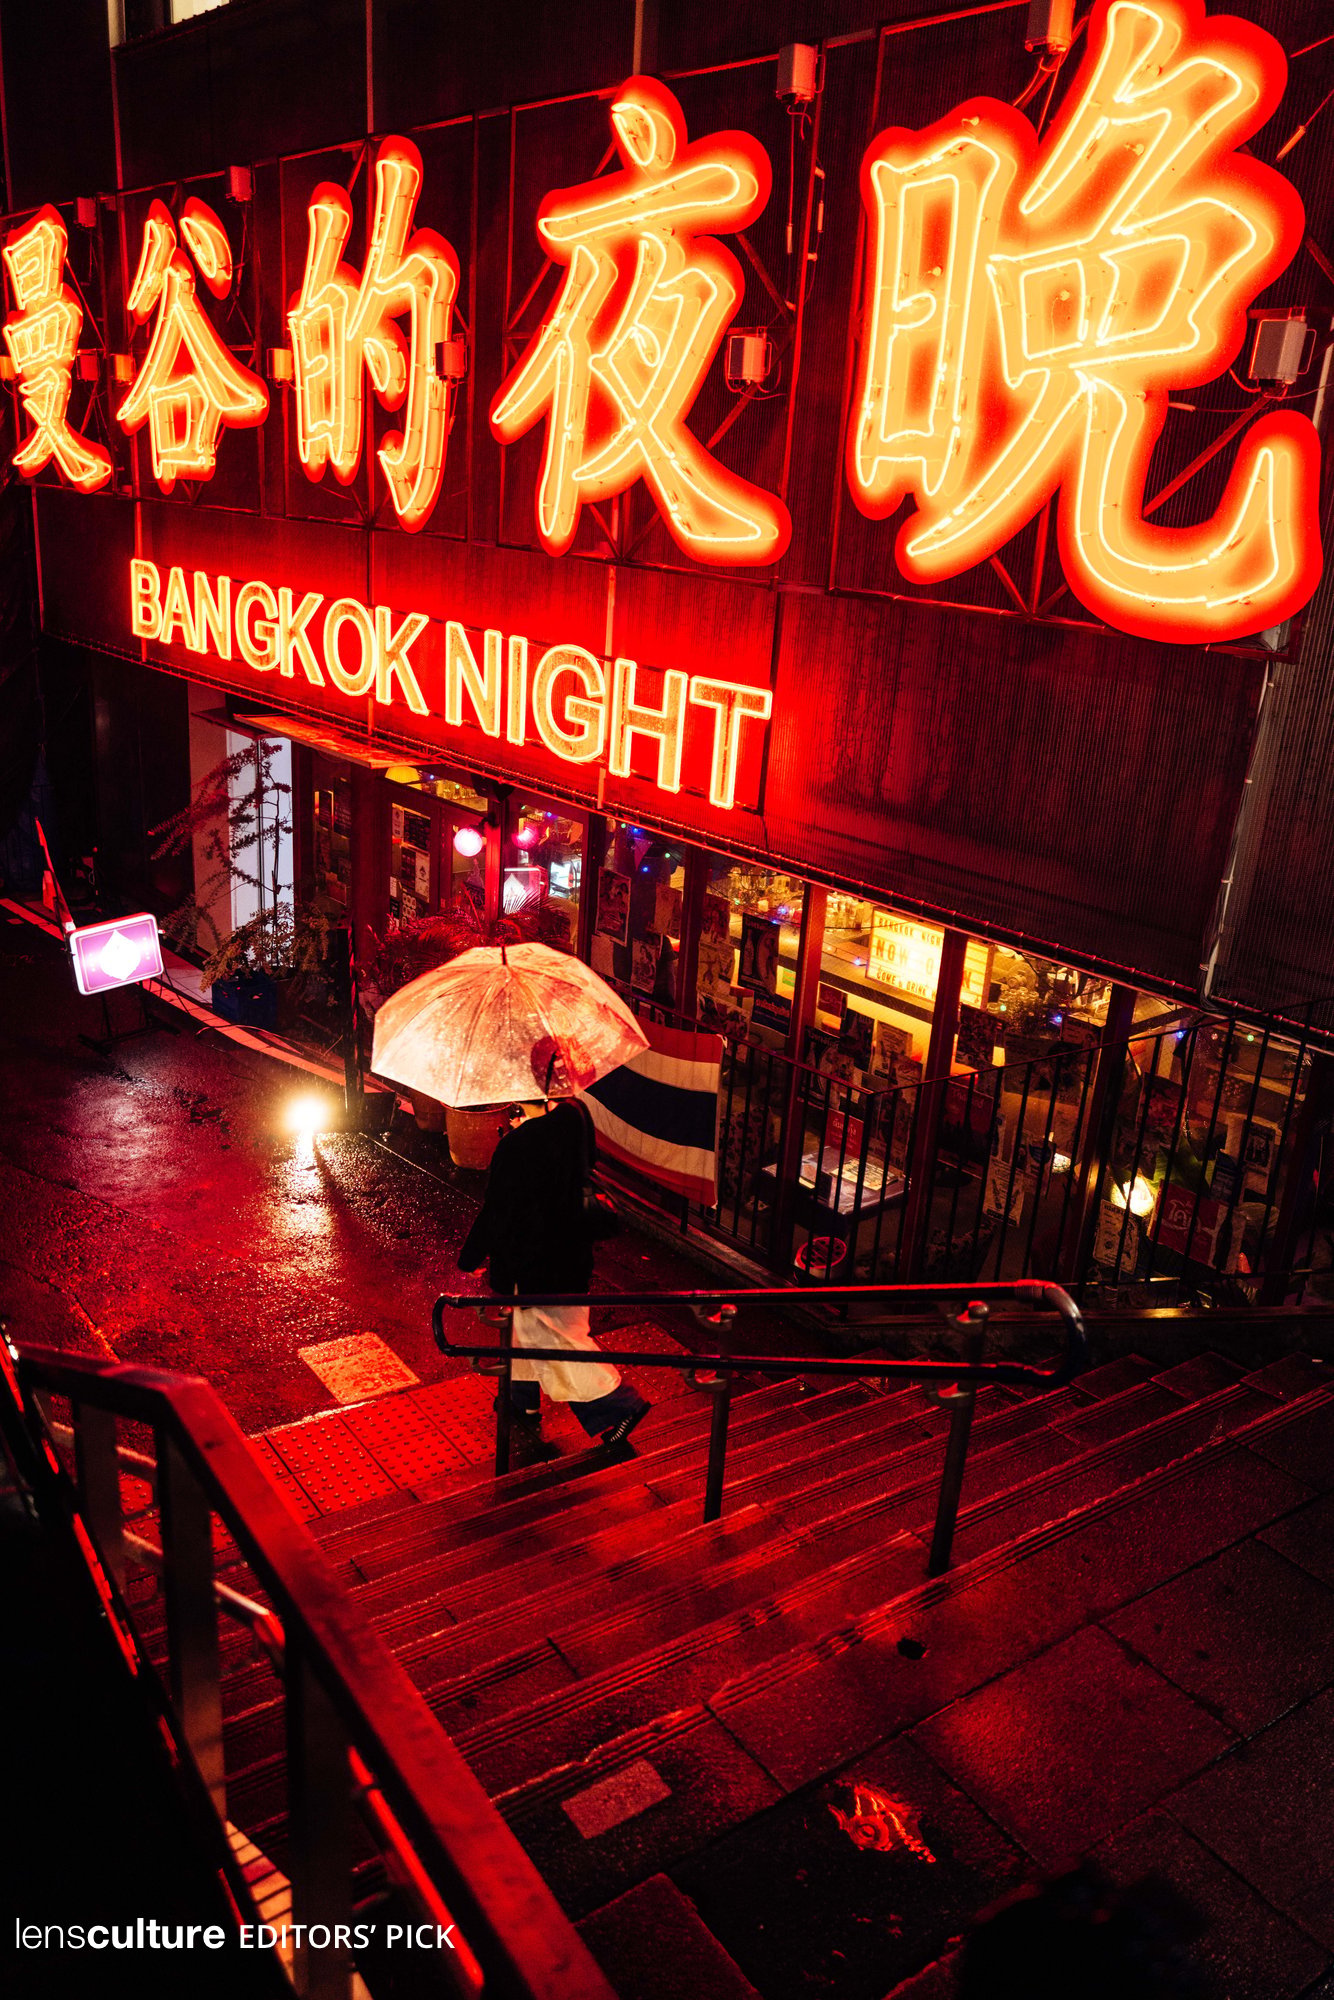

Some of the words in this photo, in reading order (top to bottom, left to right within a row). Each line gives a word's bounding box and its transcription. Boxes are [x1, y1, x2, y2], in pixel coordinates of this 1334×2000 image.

[2, 0, 1314, 634] 曼谷的夜晚
[130, 557, 429, 716] BANGKOK
[443, 620, 774, 810] NIGHT
